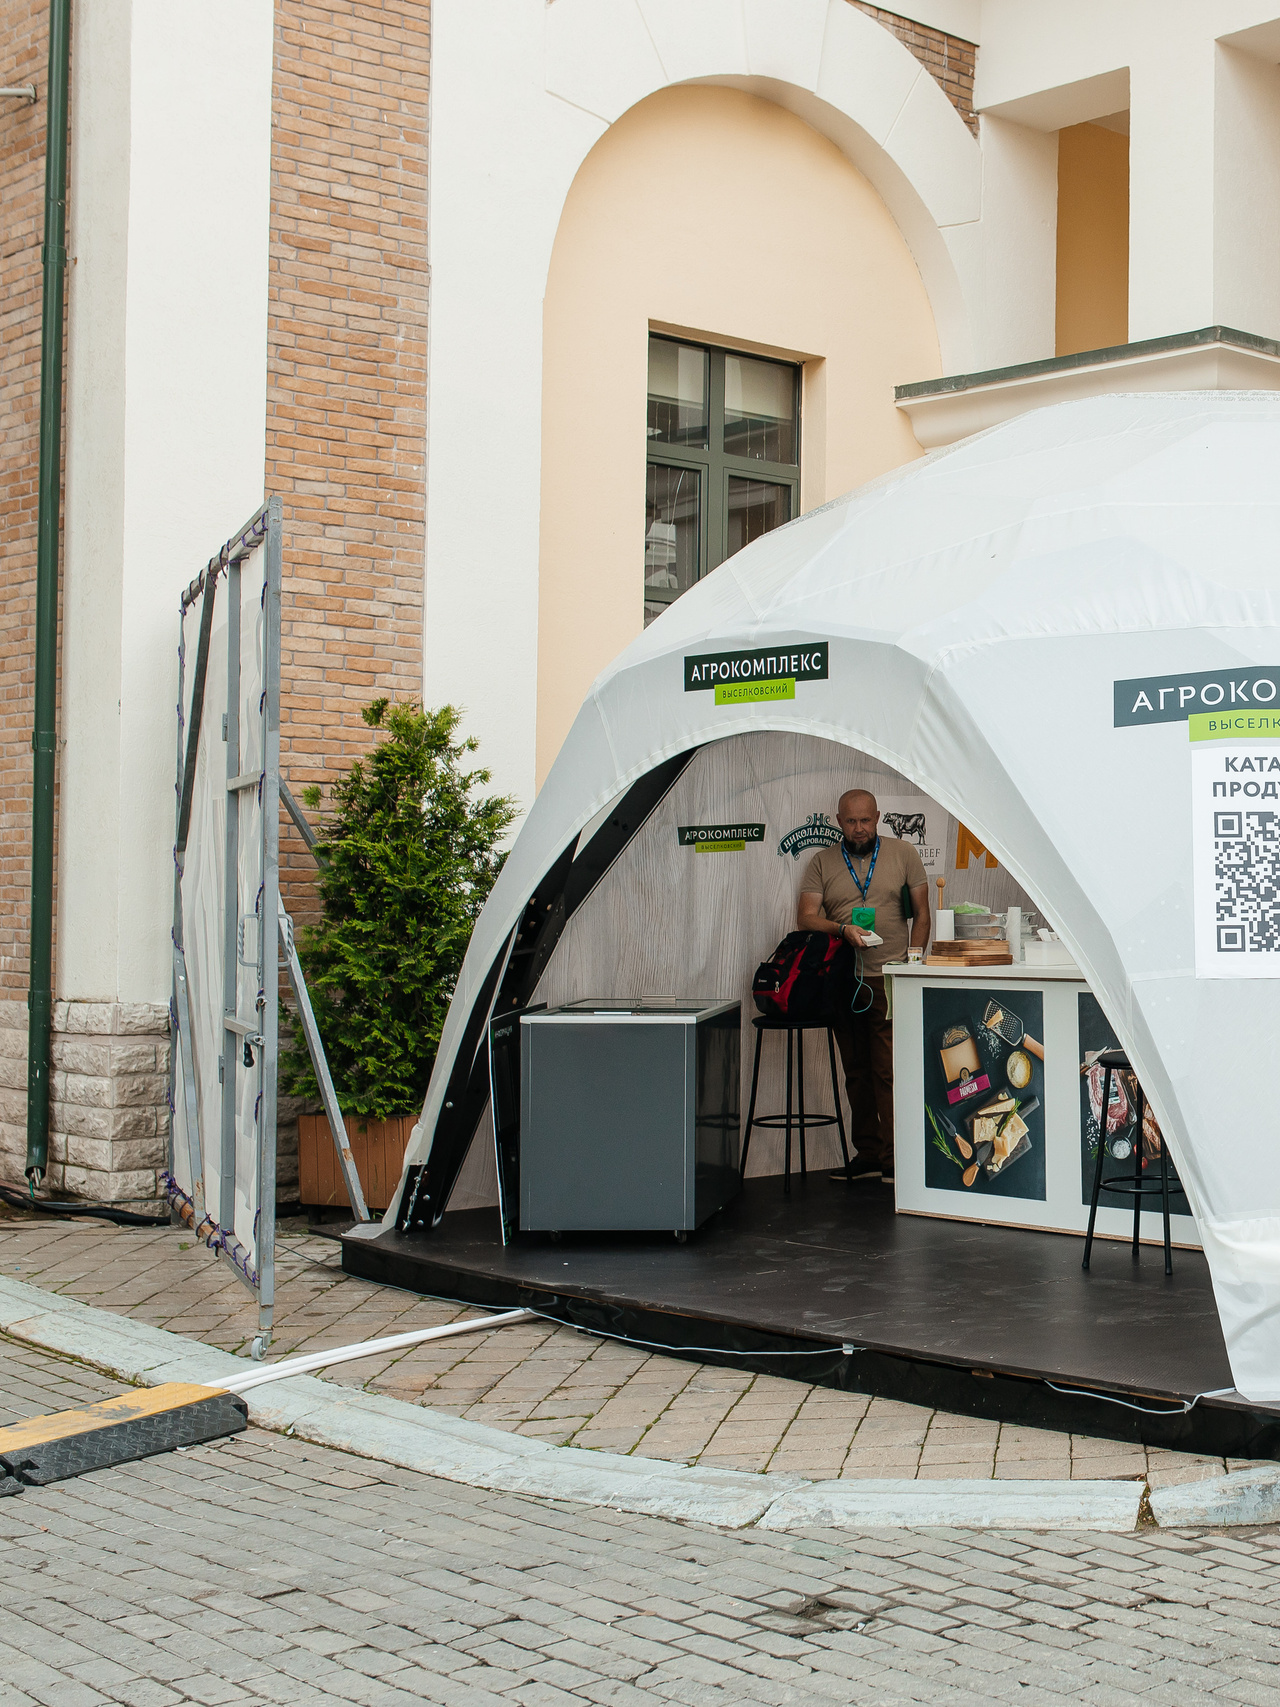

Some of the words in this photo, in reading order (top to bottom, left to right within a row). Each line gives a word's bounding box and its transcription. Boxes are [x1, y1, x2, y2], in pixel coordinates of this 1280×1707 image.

[691, 652, 822, 682] АГРОКОМПЛЕКС
[722, 683, 788, 699] ВЫСЕЛКОВСКИЙ
[684, 827, 760, 841] АГРОКОМПЛЕКС
[701, 842, 743, 850] ВЫСЕЛКОВСКИЙ
[919, 848, 941, 858] BEEF
